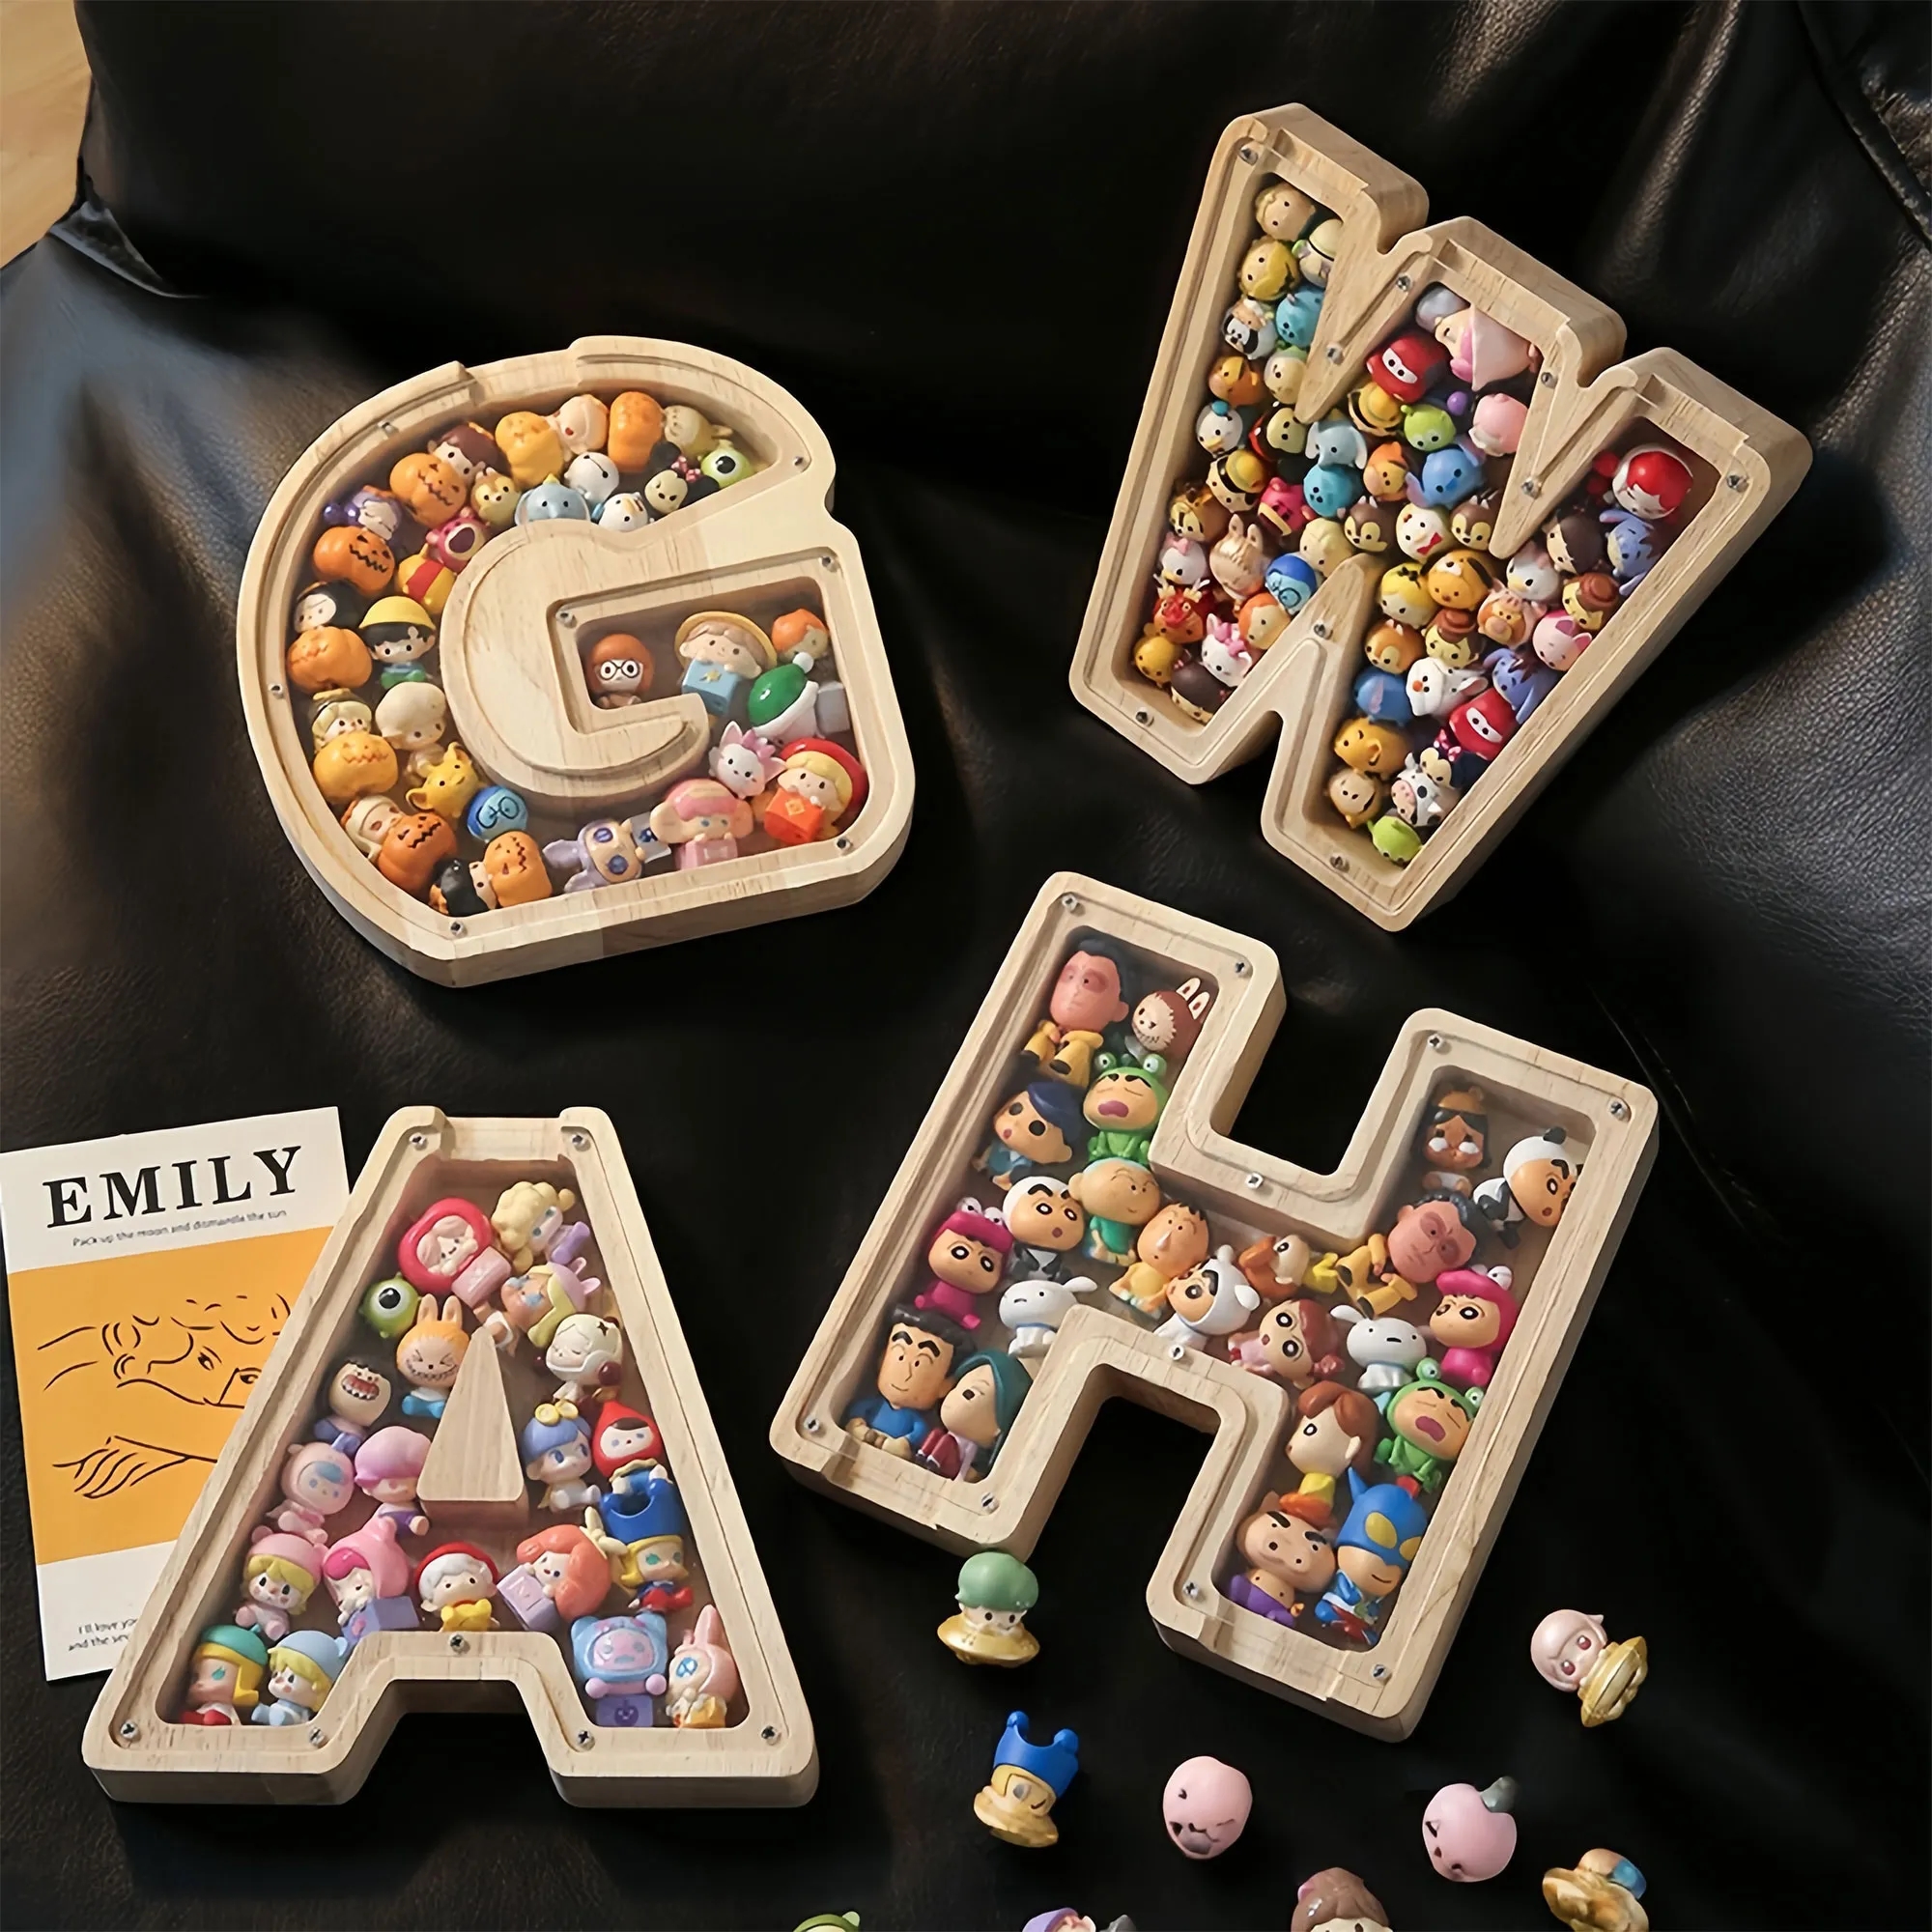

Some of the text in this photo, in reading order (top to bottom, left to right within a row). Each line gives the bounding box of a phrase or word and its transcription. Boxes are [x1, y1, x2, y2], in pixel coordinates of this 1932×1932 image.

[43, 1145, 301, 1229] EMILY
[116, 1232, 134, 1241] the
[136, 1228, 169, 1236] moon
[171, 1222, 190, 1234] and
[246, 1212, 264, 1221] the
